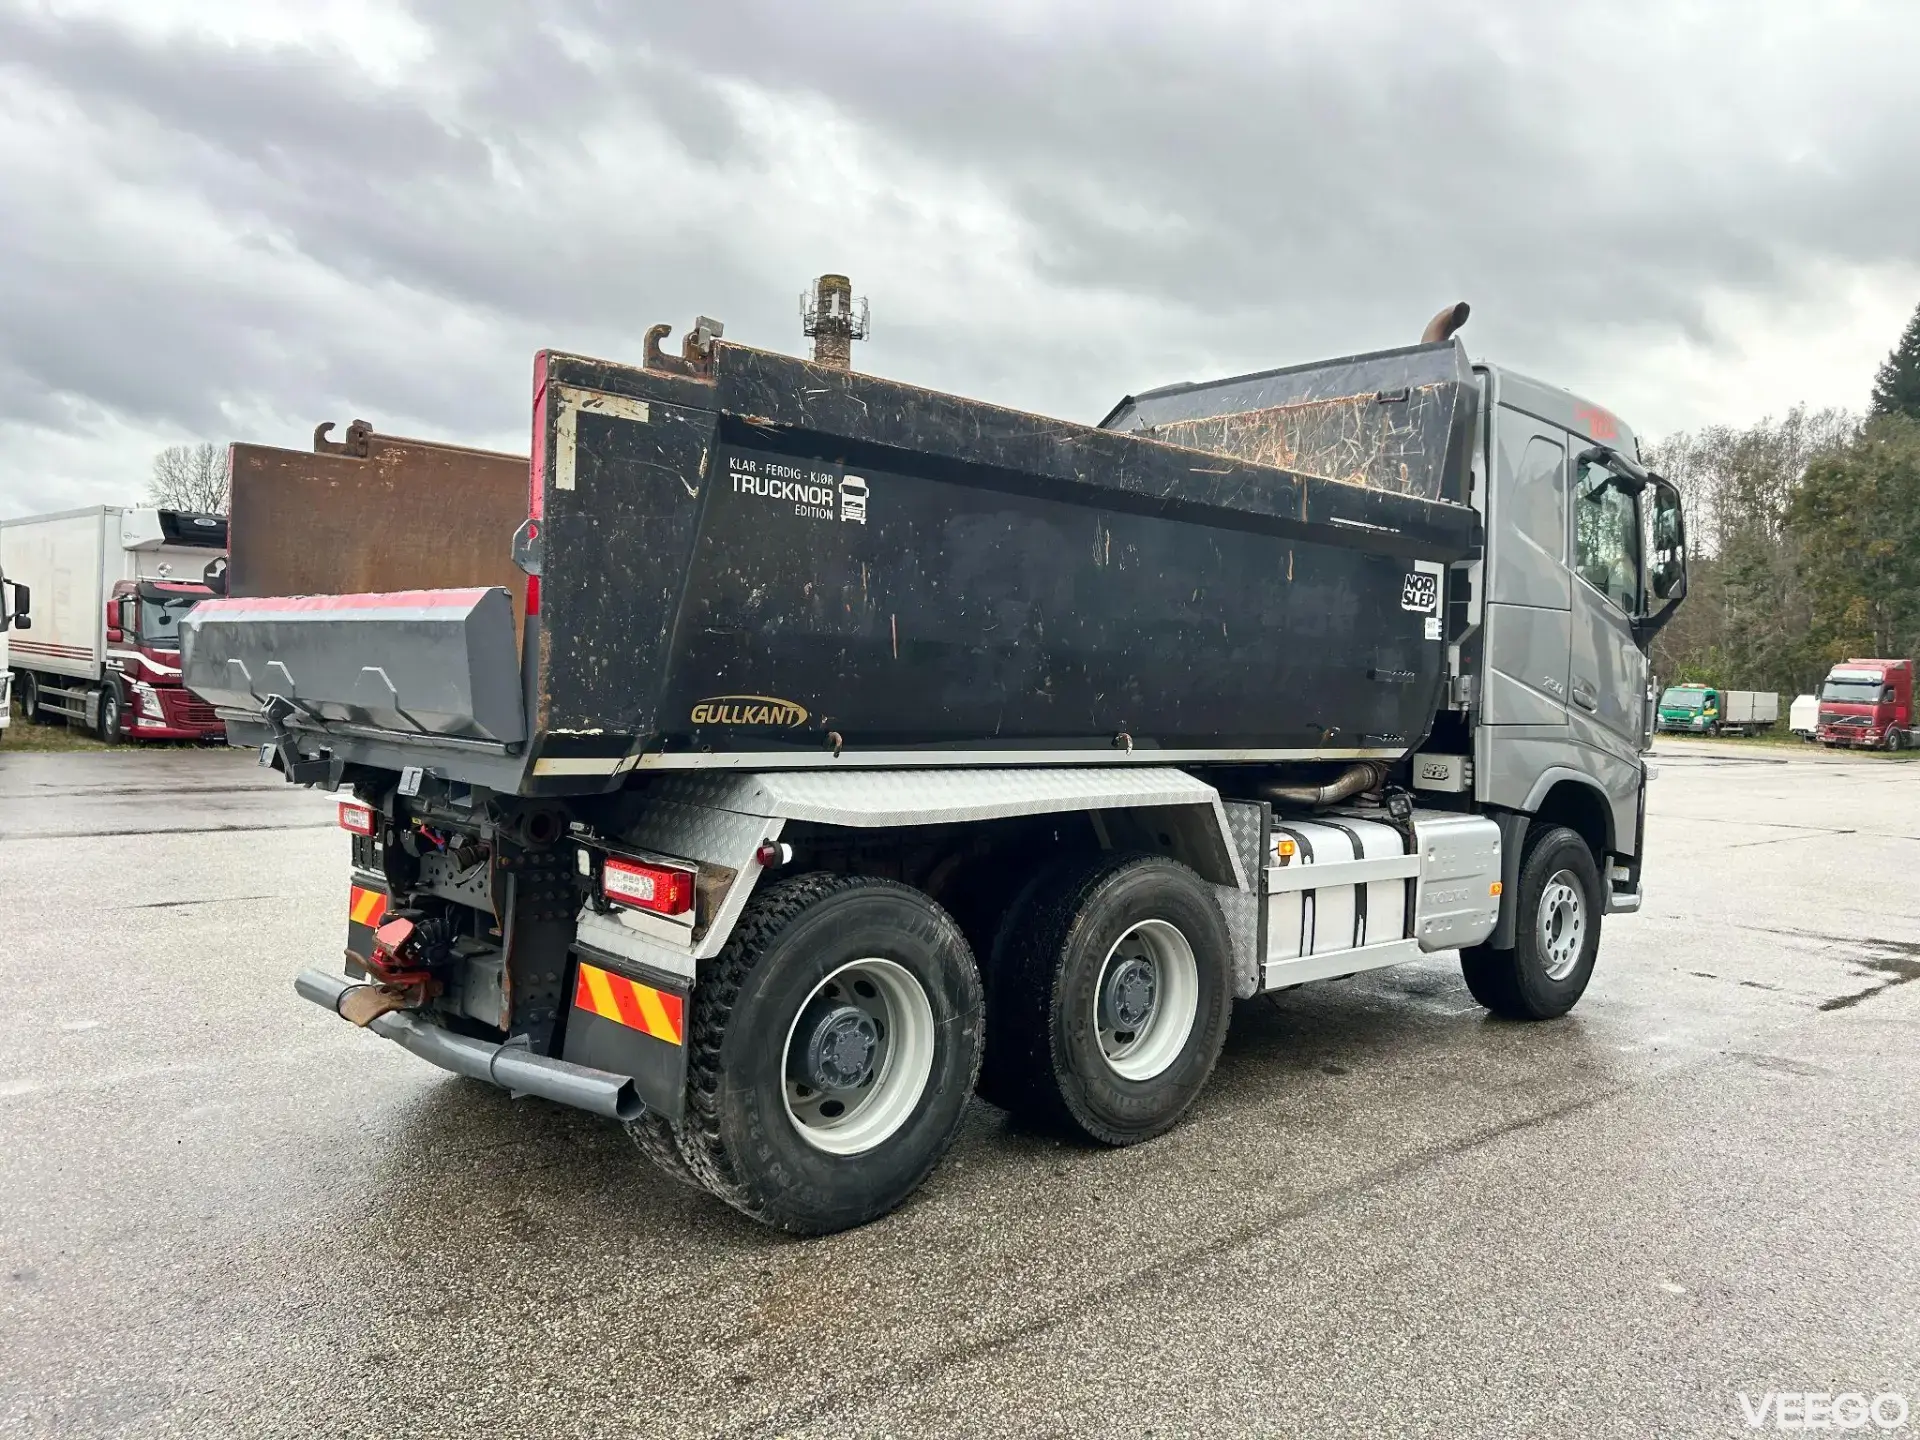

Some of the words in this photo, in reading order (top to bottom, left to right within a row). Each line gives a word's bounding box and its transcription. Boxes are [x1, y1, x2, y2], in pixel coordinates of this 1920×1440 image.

[729, 457, 756, 472] KLAR
[766, 463, 801, 479] FERDIG
[810, 471, 834, 486] KJØR
[729, 473, 834, 507] TRUCKNOR
[795, 504, 834, 520] EDITION
[1404, 574, 1435, 593] NOR
[1402, 590, 1436, 608] SLEP
[690, 704, 801, 725] GULLKANT
